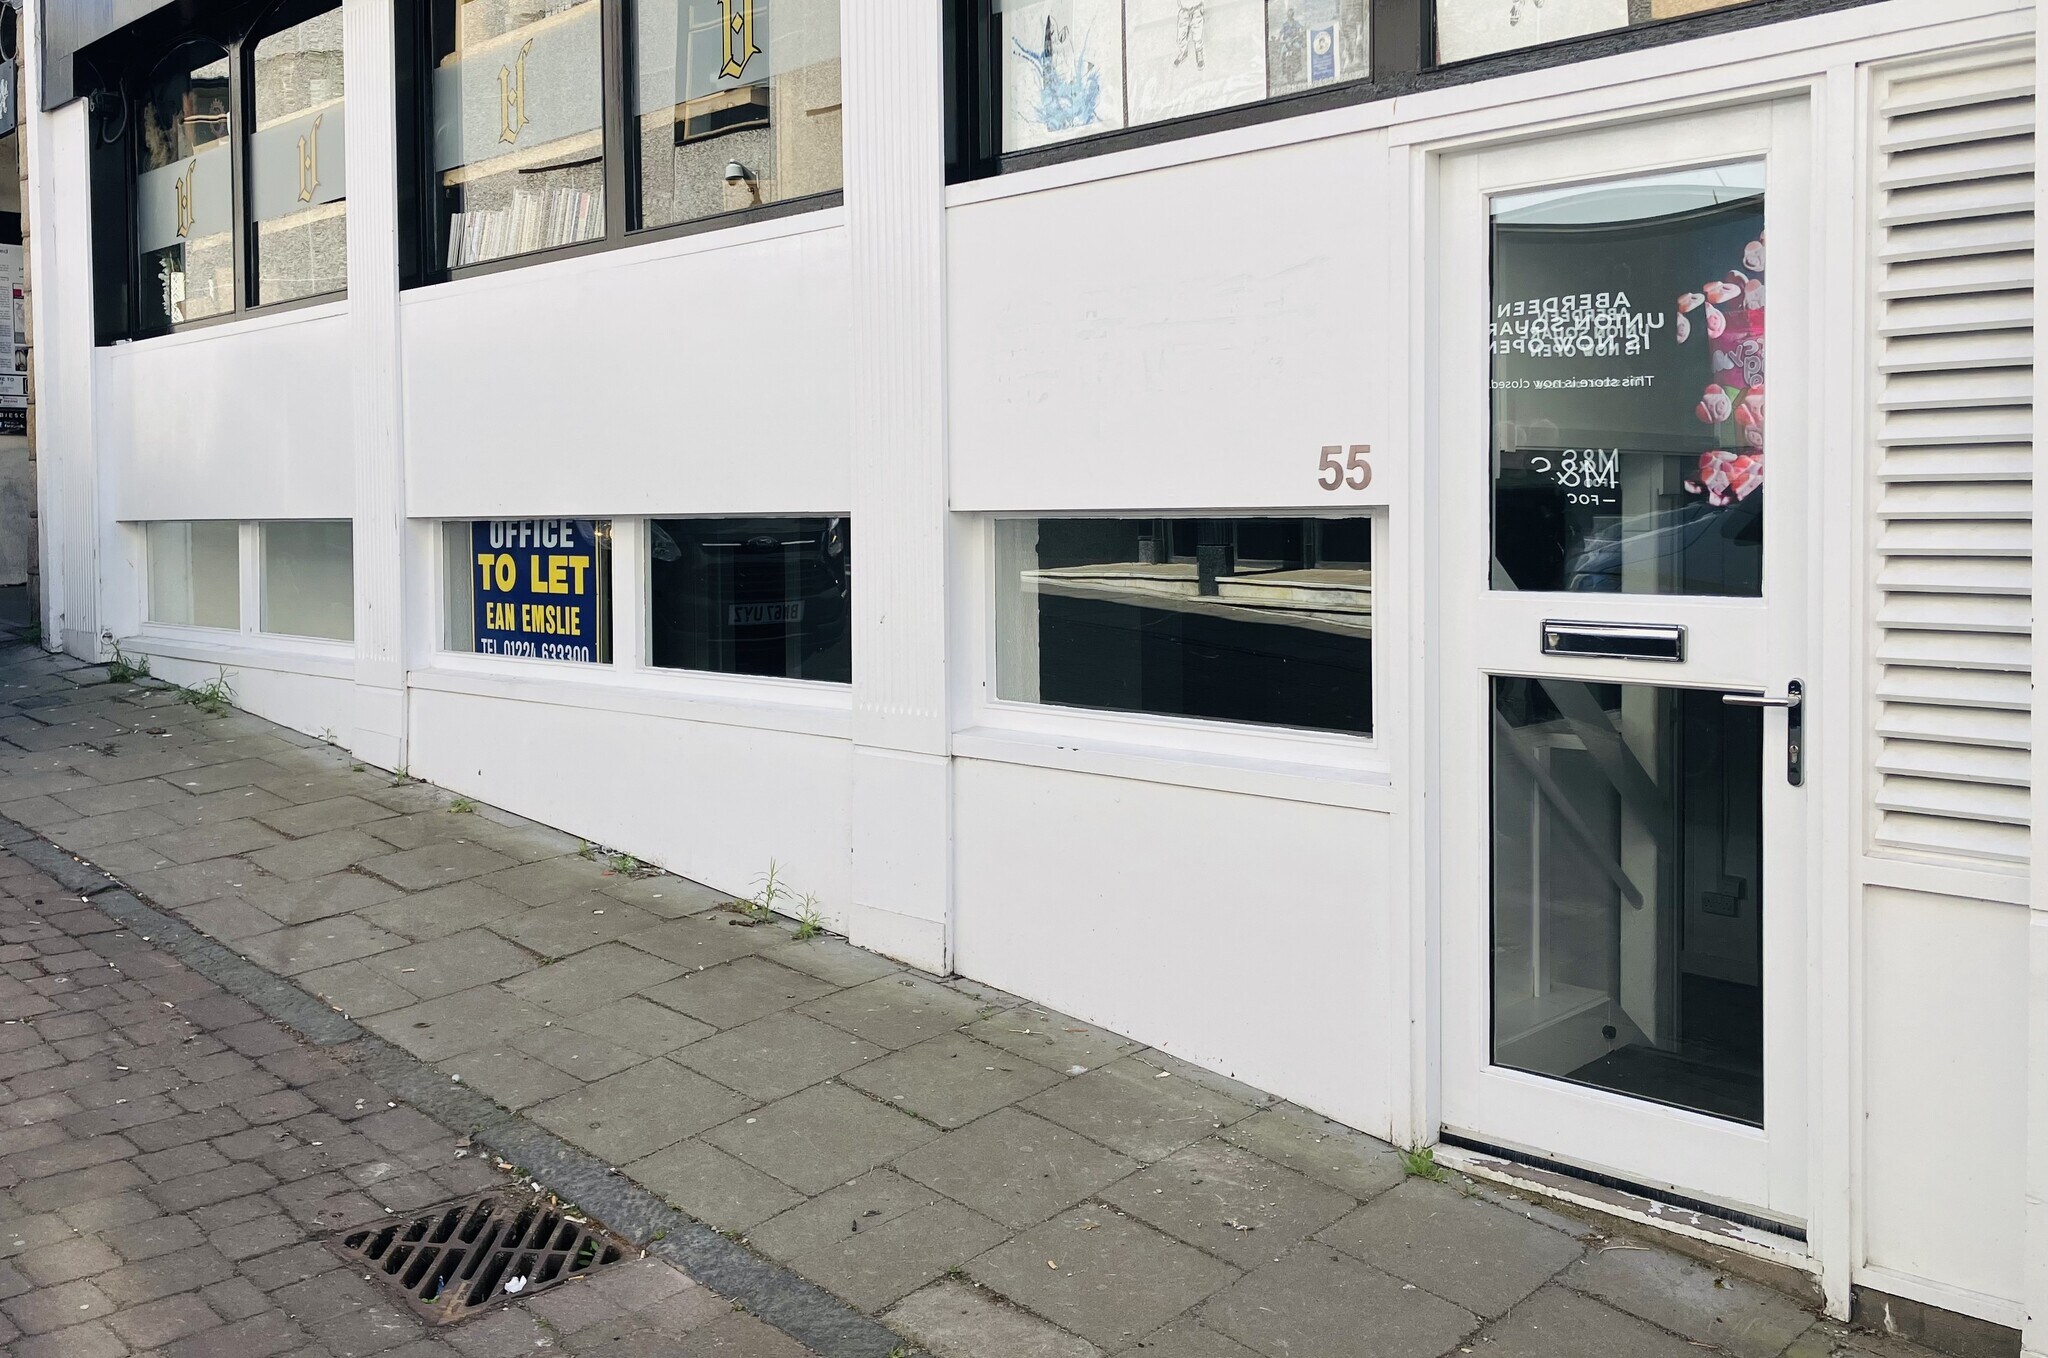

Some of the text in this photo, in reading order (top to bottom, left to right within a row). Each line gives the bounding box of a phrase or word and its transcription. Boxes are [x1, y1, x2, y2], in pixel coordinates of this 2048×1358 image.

[1318, 444, 1372, 491] 55
[490, 520, 575, 549] OFFICE
[477, 553, 590, 595] TO LET
[486, 602, 581, 636] EAN EMSLIE
[480, 638, 498, 655] TEL
[503, 640, 537, 658] 01224
